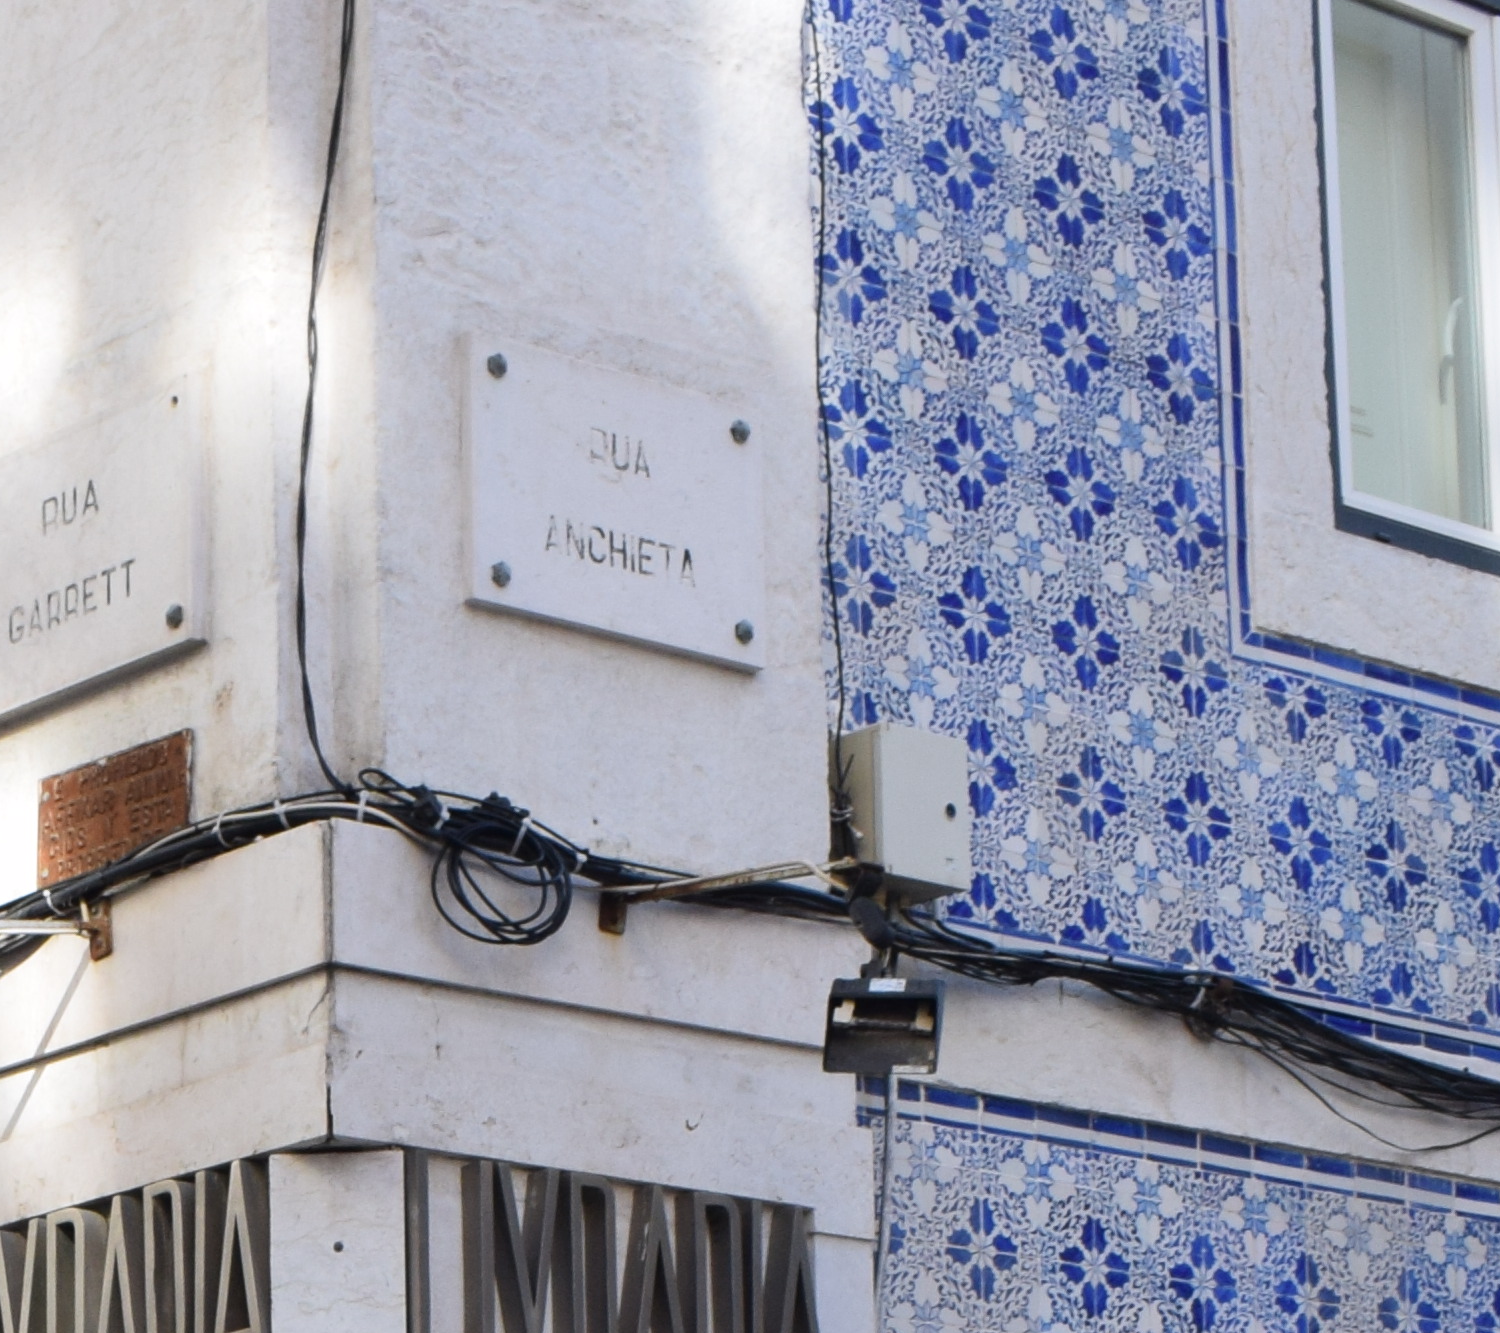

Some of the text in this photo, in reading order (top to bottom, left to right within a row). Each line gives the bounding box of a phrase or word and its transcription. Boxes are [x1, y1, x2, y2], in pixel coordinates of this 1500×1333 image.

[588, 427, 652, 480] RUA
[41, 480, 101, 536] RUA
[545, 513, 698, 588] ANCHIETA
[8, 557, 137, 646] GARRETT
